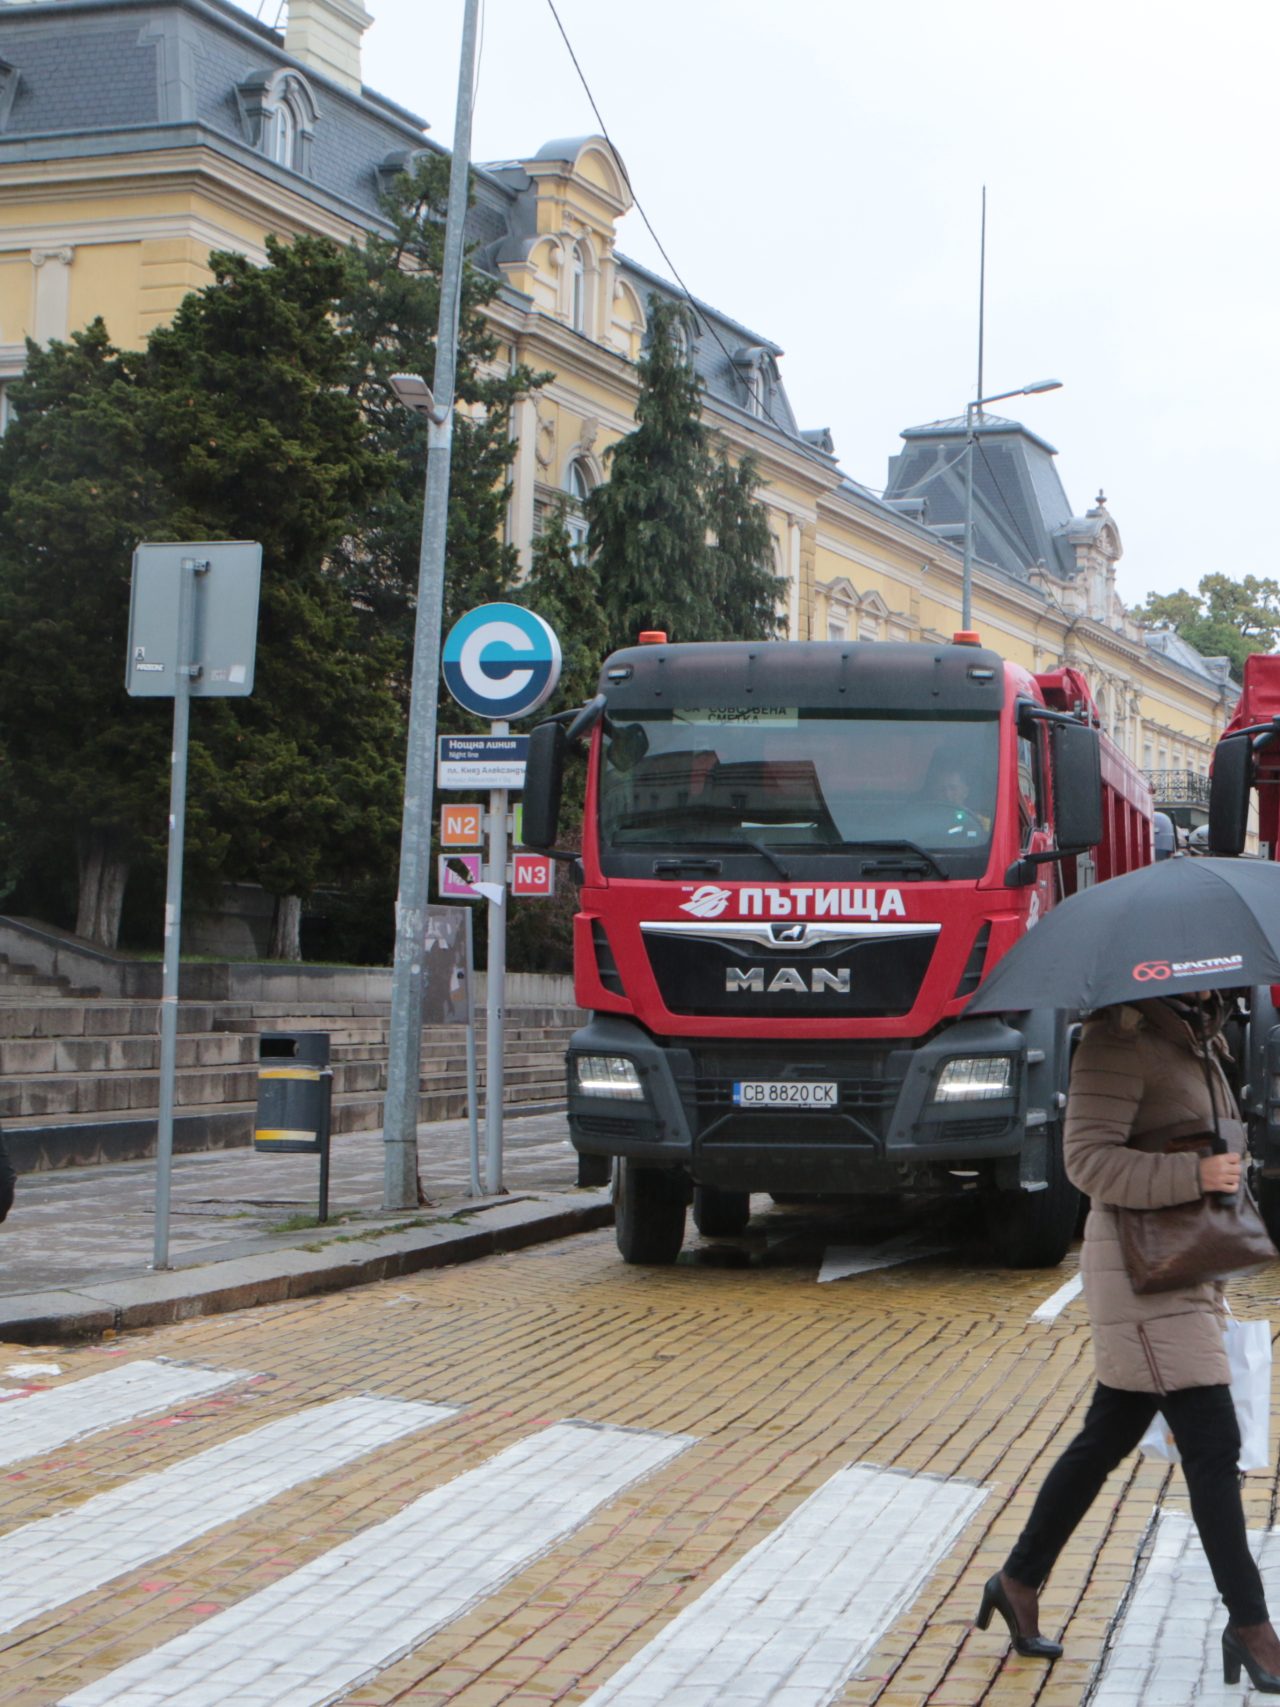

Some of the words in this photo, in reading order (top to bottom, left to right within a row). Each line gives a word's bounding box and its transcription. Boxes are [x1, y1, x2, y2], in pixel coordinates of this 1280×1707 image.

[447, 816, 476, 835] N2
[518, 866, 546, 884] N3
[738, 887, 907, 921] ПЪТИЩА
[725, 967, 851, 993] MAN
